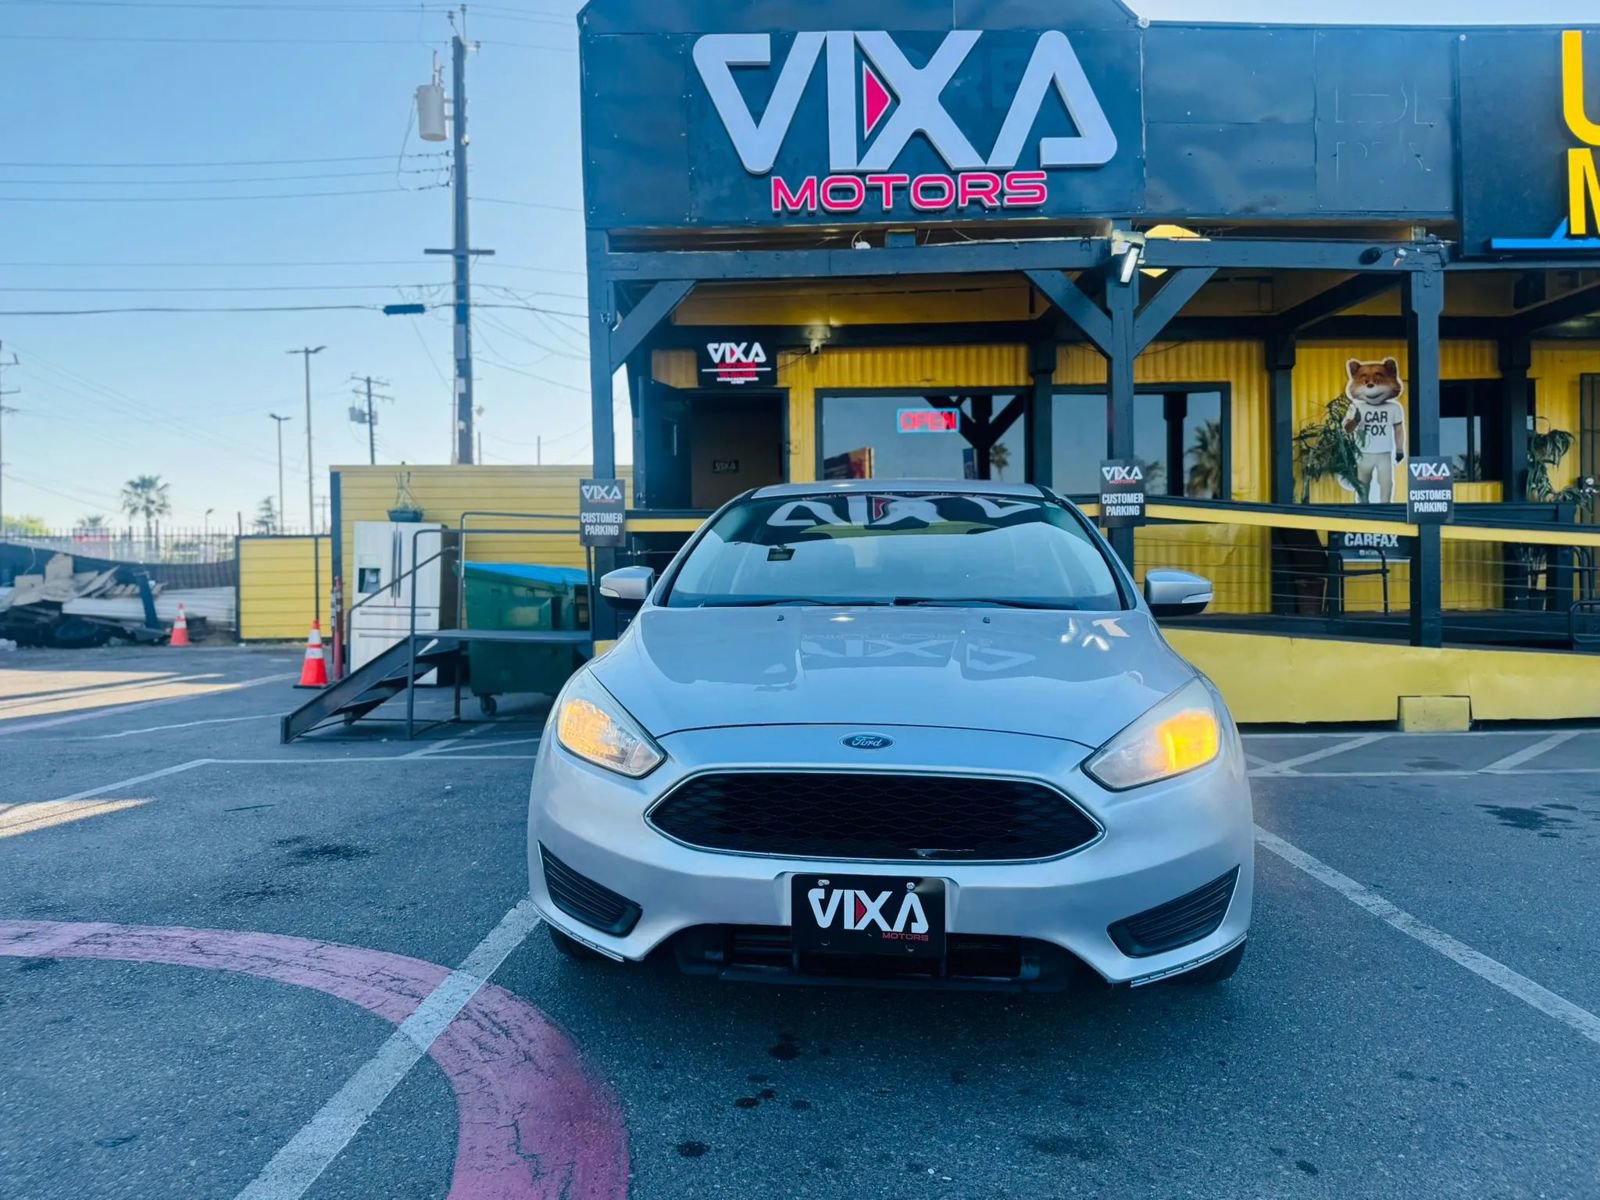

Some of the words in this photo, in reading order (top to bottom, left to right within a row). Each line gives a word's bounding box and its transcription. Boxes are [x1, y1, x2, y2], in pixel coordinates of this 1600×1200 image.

[693, 30, 1118, 175] VIXA
[771, 171, 1048, 213] MOTORS
[706, 342, 767, 363] VIXA
[901, 411, 957, 431] OPEN
[1364, 411, 1388, 423] CAR
[1364, 425, 1386, 436] FOX
[1102, 465, 1143, 480] VIXA
[1410, 463, 1450, 477] VIXA
[581, 485, 622, 500] VIXA
[1102, 493, 1144, 504] CUSTOMER
[1410, 490, 1452, 501] CUSTOMER
[1106, 505, 1140, 516] PARKING
[1414, 502, 1448, 512] PARKING
[581, 512, 623, 523] CUSTOMER
[585, 525, 619, 536] PARKING
[1344, 532, 1399, 547] CARFAX
[852, 736, 882, 747] Ford
[808, 888, 929, 934] VIXA
[882, 932, 929, 941] MOTORS
